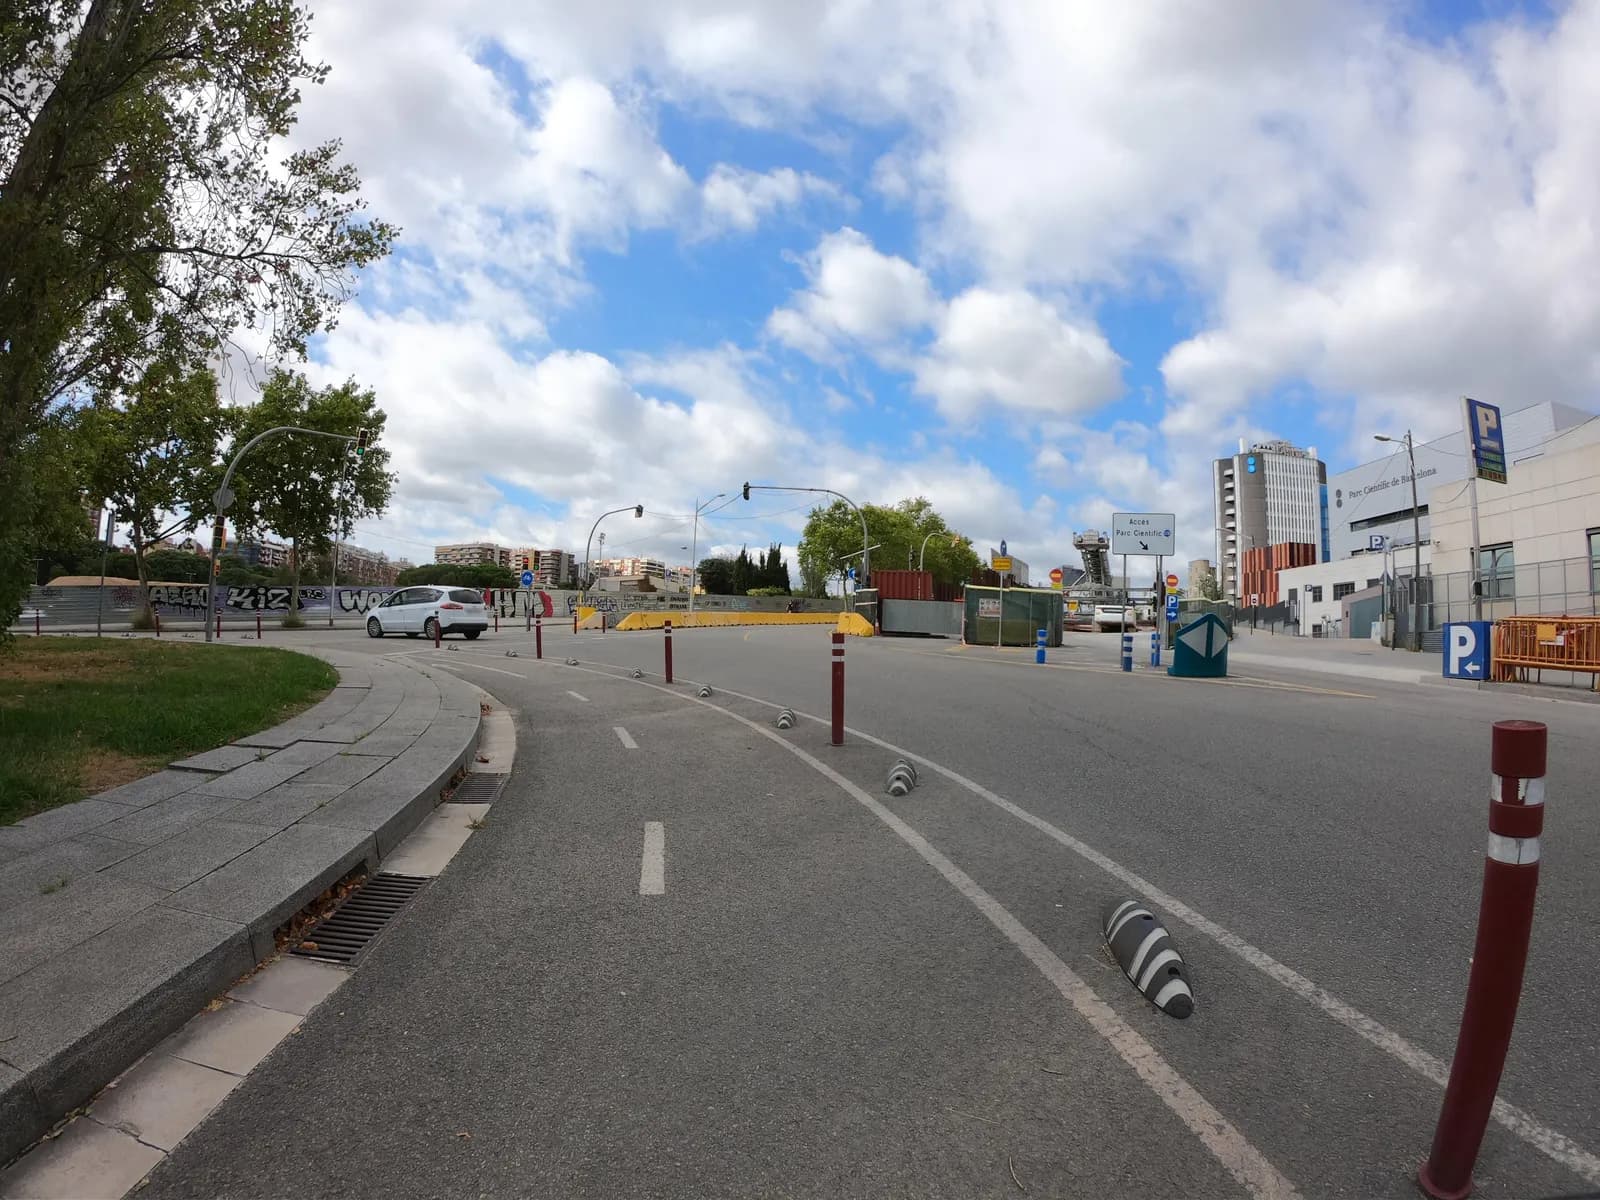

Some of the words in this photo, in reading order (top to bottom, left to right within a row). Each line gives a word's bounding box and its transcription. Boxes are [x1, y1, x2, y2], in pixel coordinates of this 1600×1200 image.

[1476, 405, 1498, 438] P
[1348, 489, 1363, 499] Parc
[1391, 476, 1400, 487] de
[1116, 529, 1131, 537] Parc
[1371, 536, 1384, 549] P
[1168, 596, 1177, 607] P
[1449, 625, 1476, 675] P
